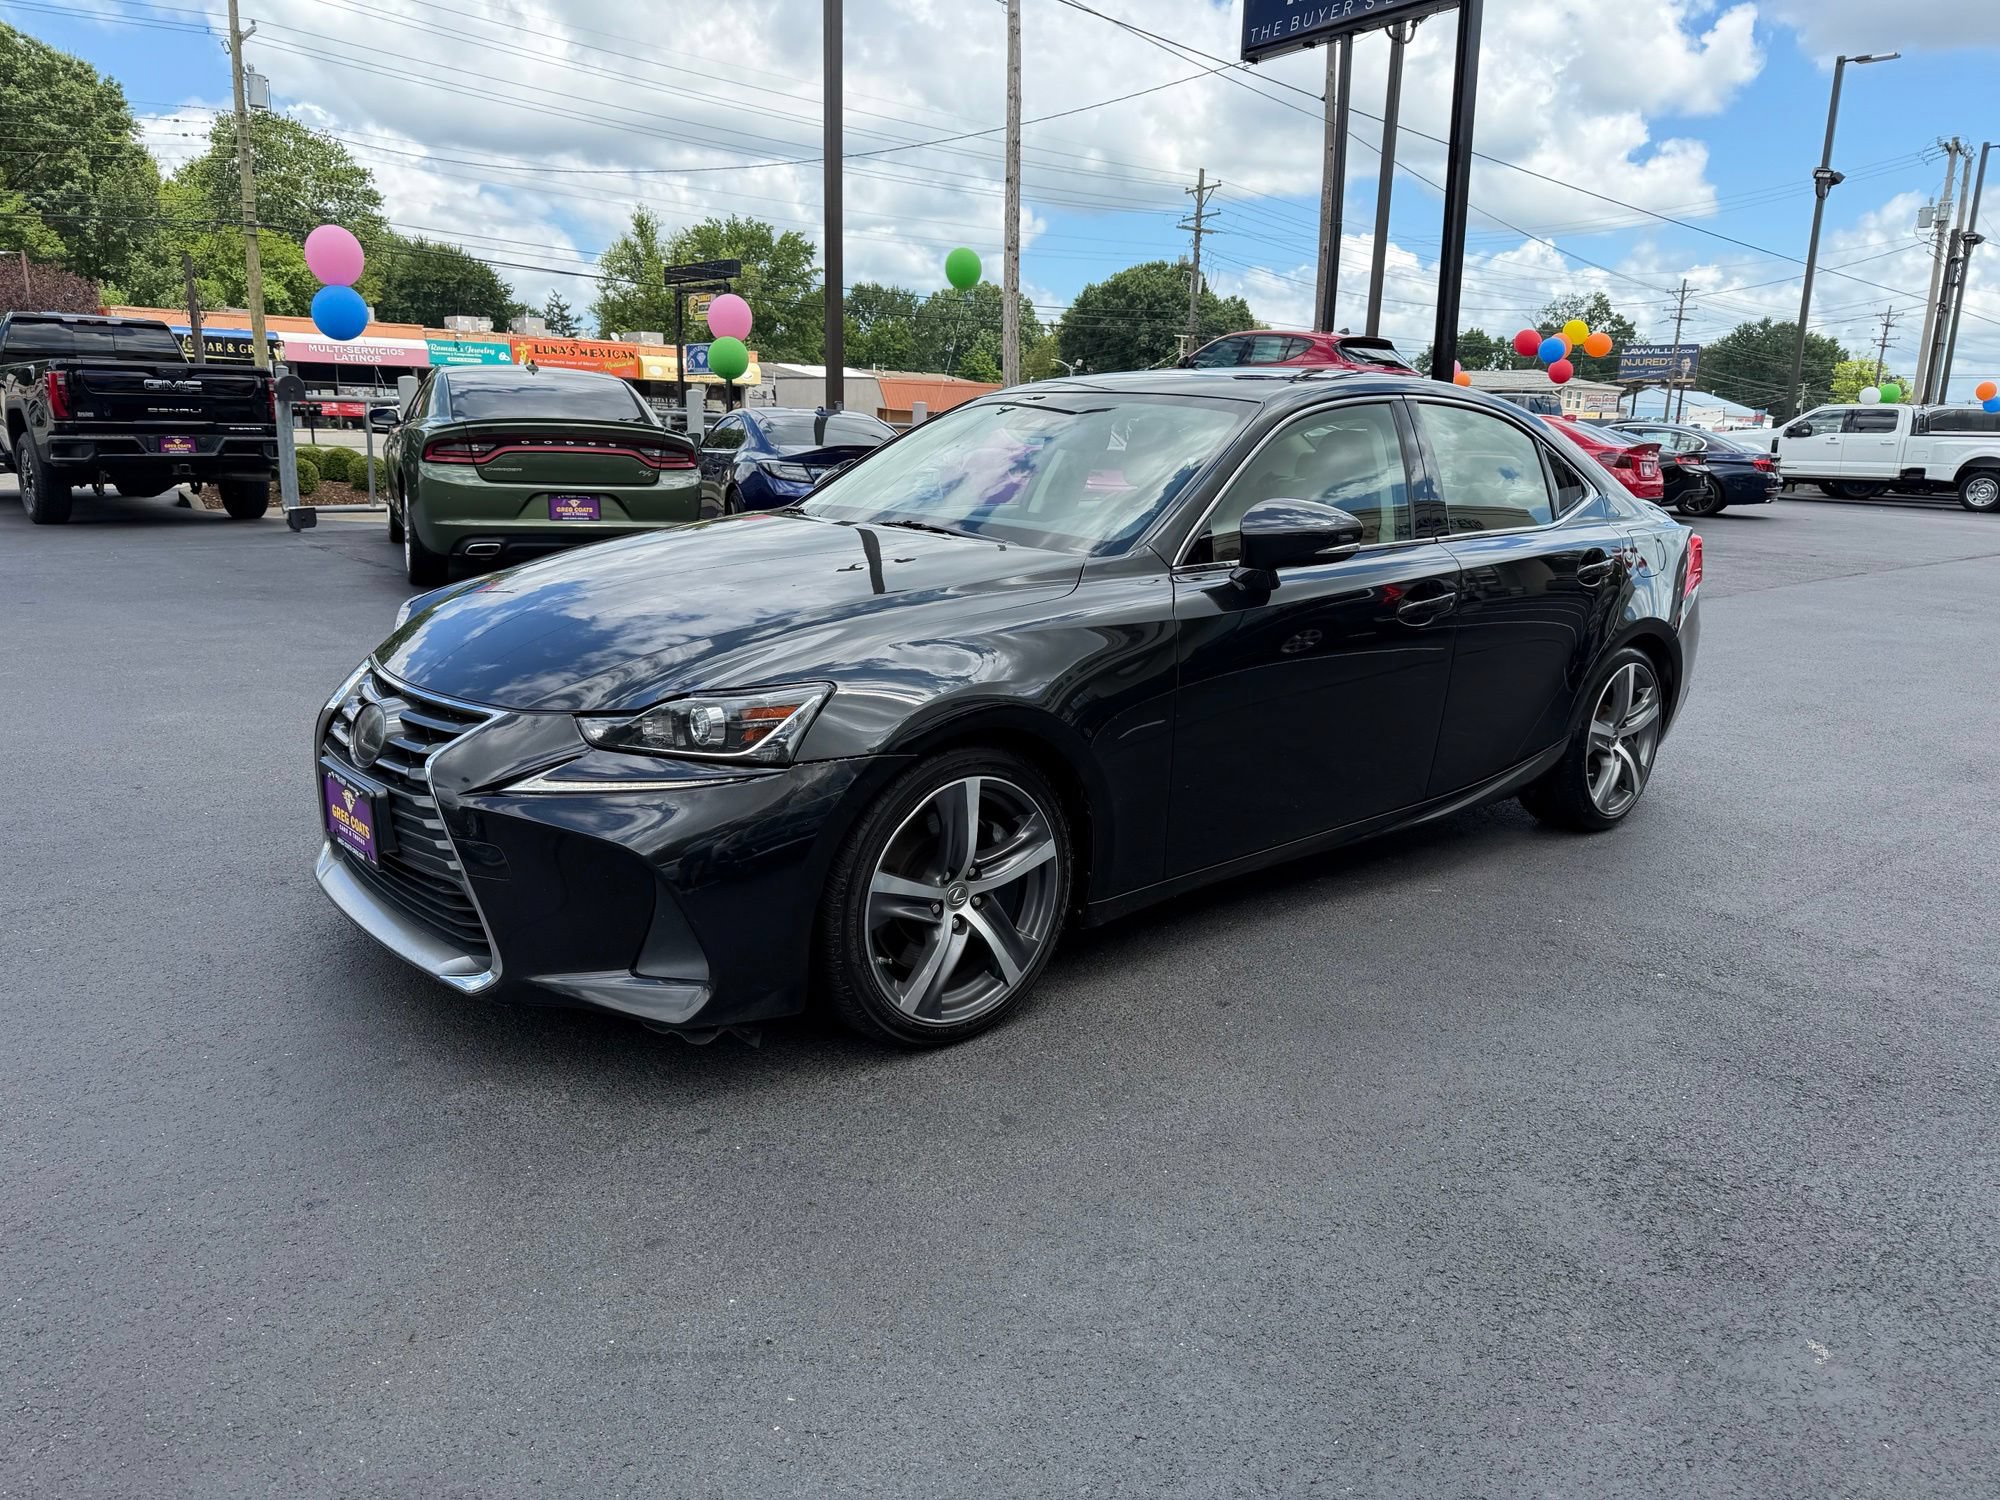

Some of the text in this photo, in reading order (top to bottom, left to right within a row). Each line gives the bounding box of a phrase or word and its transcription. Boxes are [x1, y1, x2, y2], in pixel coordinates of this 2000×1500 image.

[1251, 20, 1283, 43] THE
[203, 341, 224, 352] AR
[226, 343, 236, 353] &
[308, 344, 405, 356] MULTI-SERVICIOS
[534, 344, 635, 360] LUNA'S MEXICAN
[334, 353, 382, 363] LATINOS
[1621, 357, 1673, 366] INJURED?
[143, 379, 203, 391] GMC
[332, 804, 370, 839] GREG COATS
